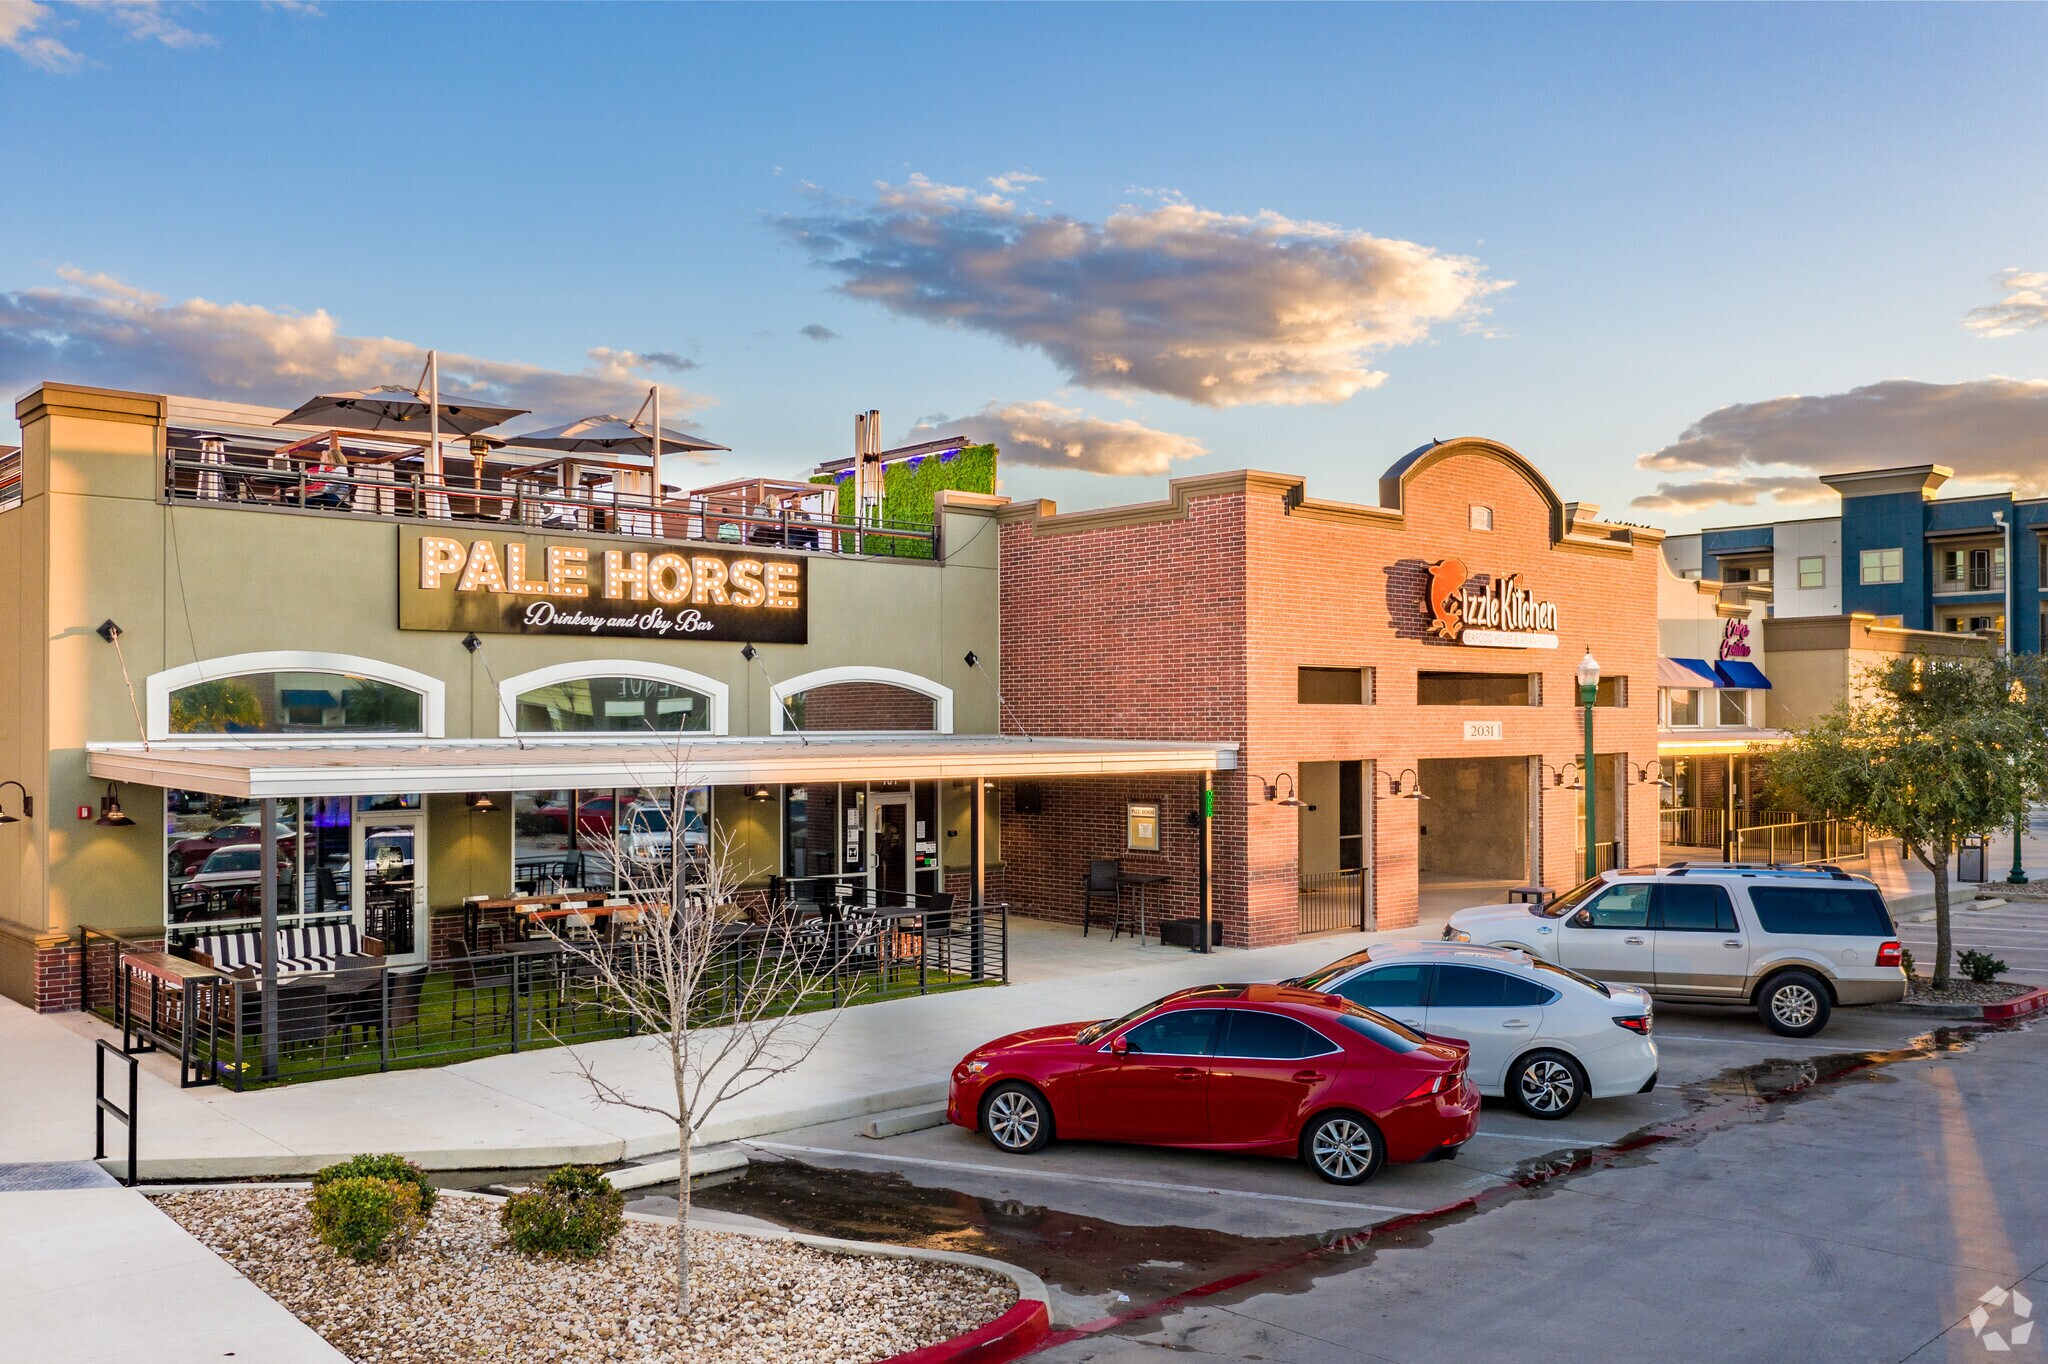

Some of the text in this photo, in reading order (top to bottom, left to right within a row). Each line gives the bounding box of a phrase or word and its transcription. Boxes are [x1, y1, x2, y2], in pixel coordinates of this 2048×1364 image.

[419, 536, 799, 609] PALE HORSE
[523, 601, 715, 635] Drinkery and Sky Bar
[1501, 578, 1558, 631] Kitchen
[1470, 725, 1495, 737] 2031
